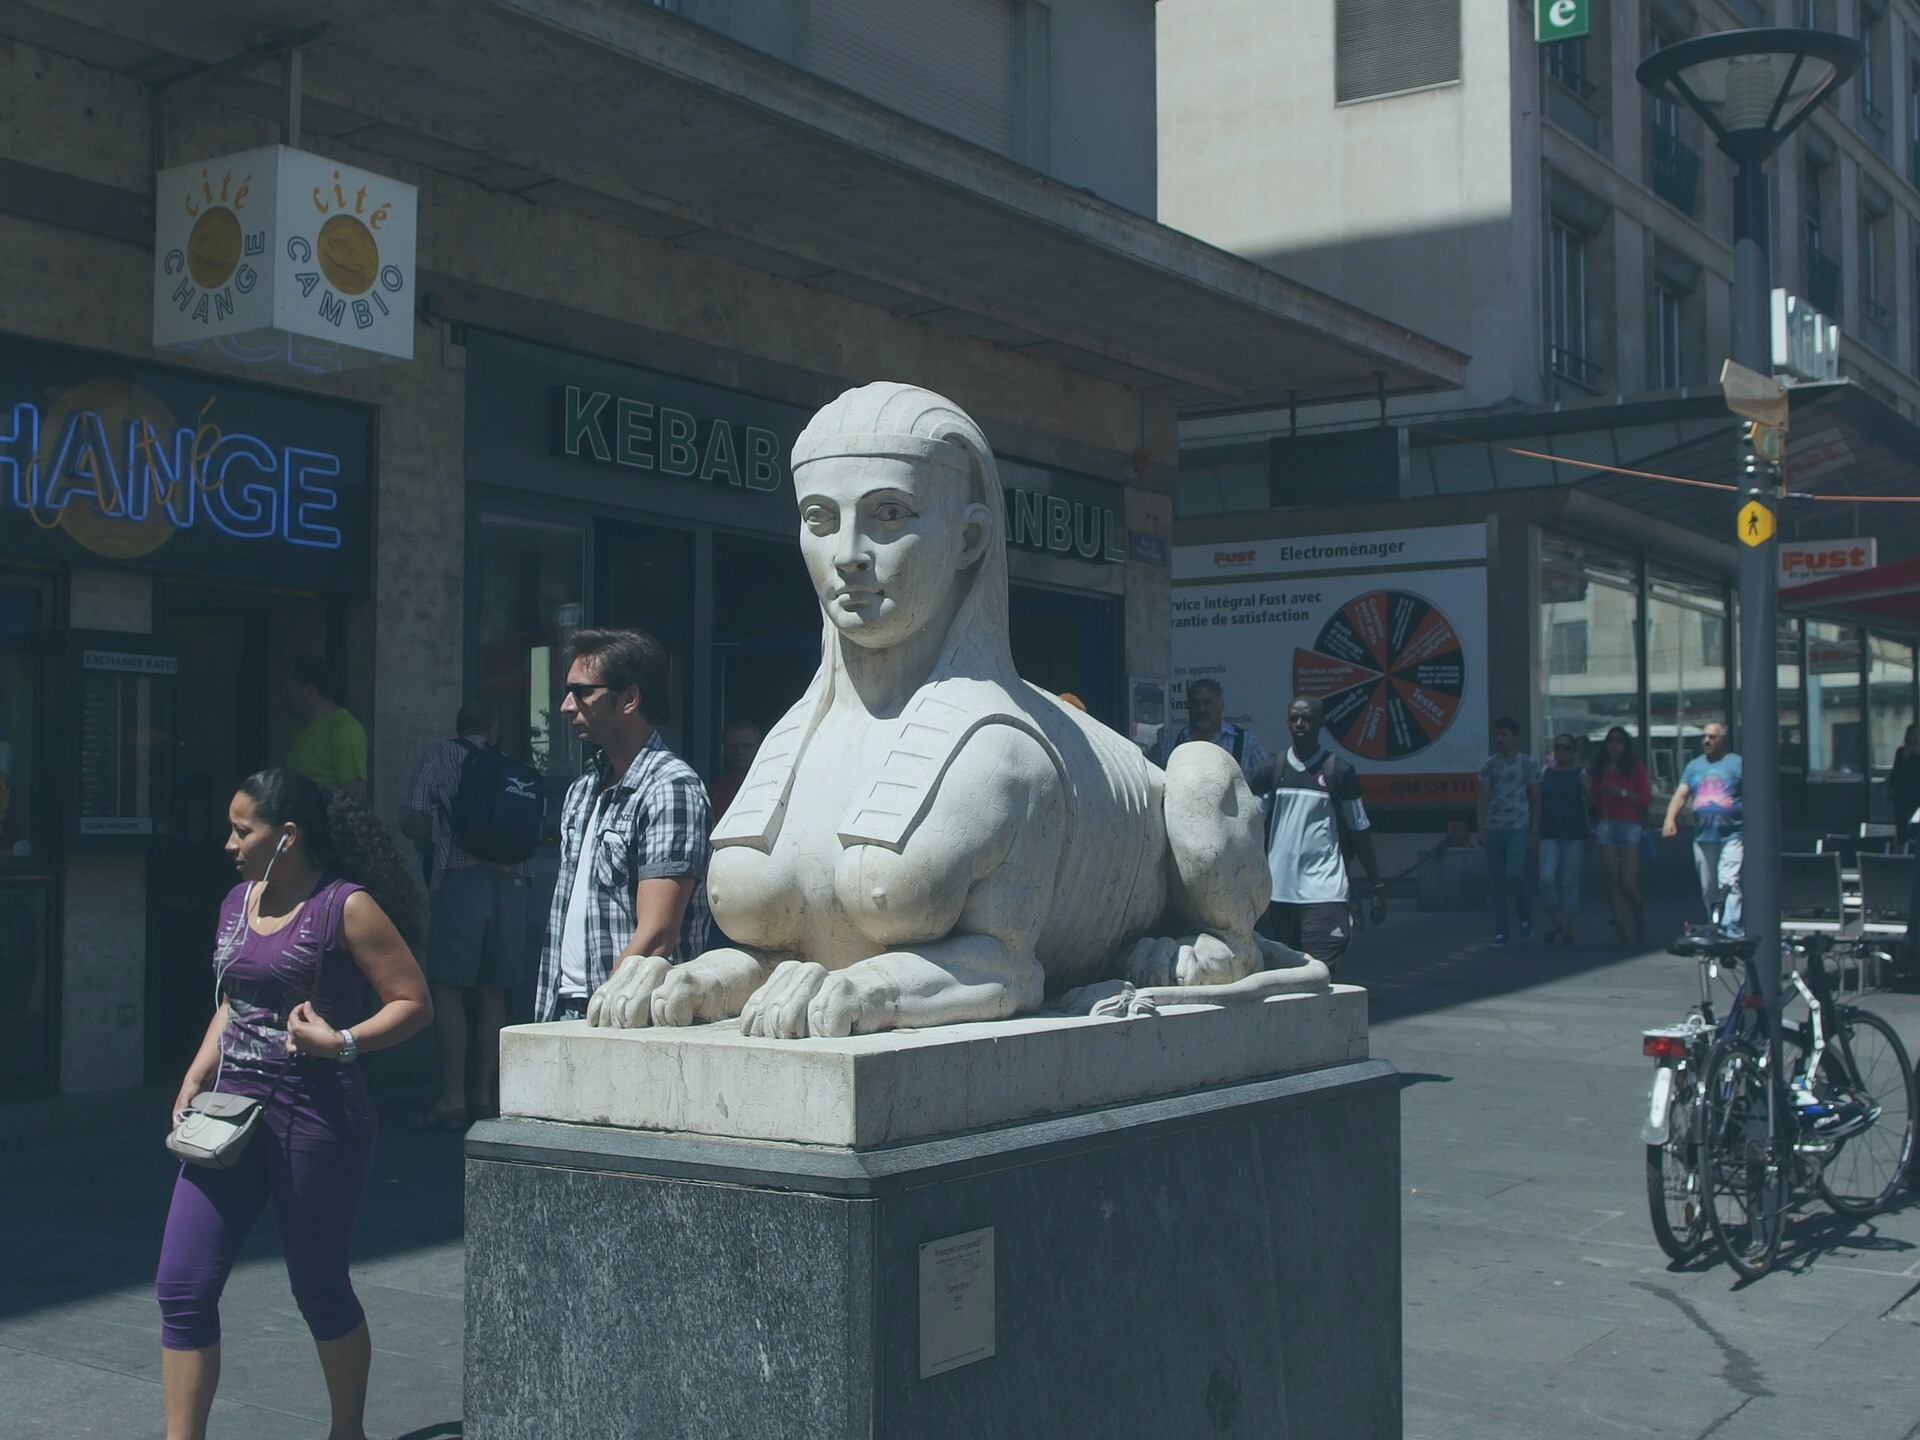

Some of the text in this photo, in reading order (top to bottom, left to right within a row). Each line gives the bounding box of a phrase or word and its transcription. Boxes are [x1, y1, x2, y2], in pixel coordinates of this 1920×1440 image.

[185, 169, 253, 218] cité
[312, 170, 392, 230] cité
[164, 230, 265, 324] CHANGE
[287, 235, 403, 329] CAMBIO
[565, 384, 782, 492] KEBAB
[1005, 488, 1126, 563] NBUL
[1214, 541, 1406, 564] Fust Electroménager
[1782, 546, 1866, 572] Fust
[1204, 594, 1255, 612] intégral
[1260, 593, 1286, 606] Fust
[1291, 592, 1322, 604] avec
[1212, 613, 1228, 626] de
[1232, 609, 1309, 624] satisfaction
[86, 653, 177, 671] EXCHANGE RATES
[1410, 686, 1446, 718] Testez
[1389, 781, 1421, 794] 0848
[1423, 781, 1448, 793] 559
[1452, 780, 1475, 793] 111
